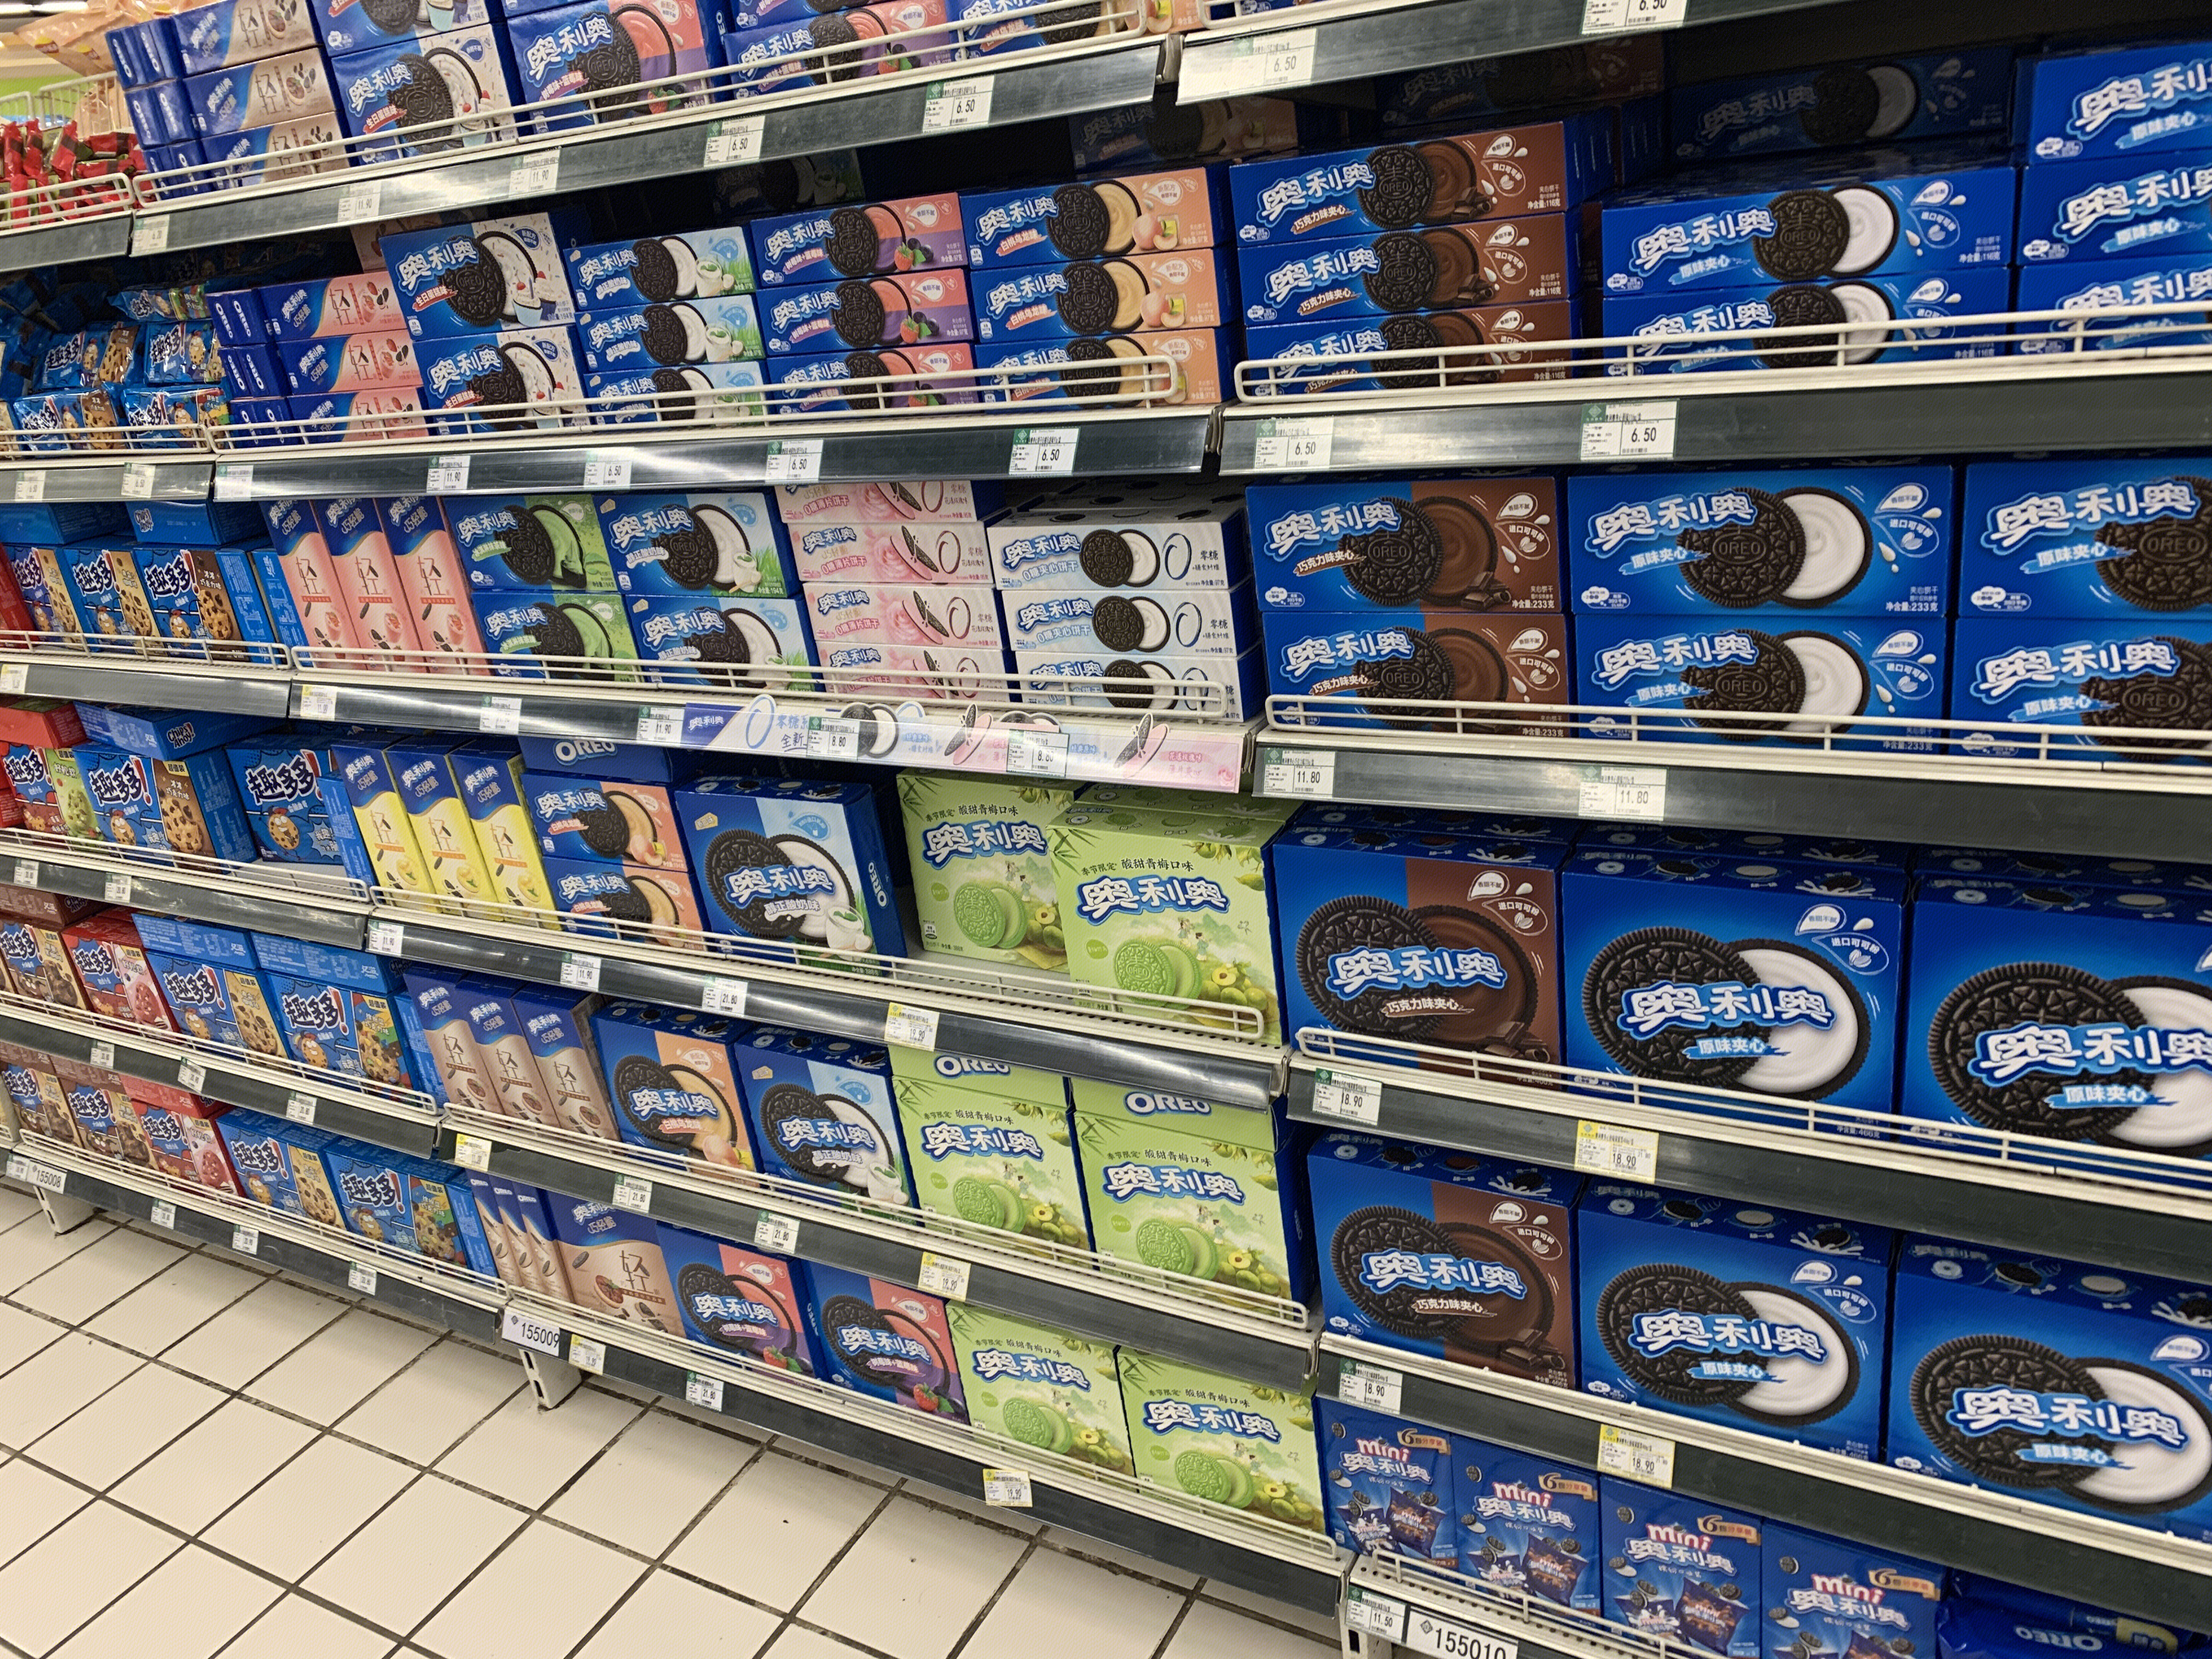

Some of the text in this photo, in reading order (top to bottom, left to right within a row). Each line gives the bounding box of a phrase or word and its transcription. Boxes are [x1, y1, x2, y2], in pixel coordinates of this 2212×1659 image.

[527, 16, 612, 80] 奥利奥
[1273, 56, 1297, 72] 6.50
[956, 99, 977, 114] 6.50
[365, 104, 399, 132] 生日蛋糕味
[2130, 111, 2197, 141] 原味夹心
[732, 137, 748, 152] 6.50
[532, 170, 549, 184] 11.90
[1381, 180, 1410, 193] OREO
[1261, 163, 1373, 221] 奥利奥
[979, 195, 1057, 239] 奥利奥
[1294, 204, 1347, 232] 巧克力味夹心
[767, 219, 833, 259] 奥利奥
[1000, 229, 1038, 252] 白桃乌龙味
[1634, 209, 1775, 272] 奥利奥
[2115, 217, 2181, 245] 原味夹心
[399, 238, 477, 287] 奥利奥
[1679, 255, 1731, 280] 原味夹心
[1269, 248, 1379, 301] 奥利奥
[415, 285, 448, 307] 生日蛋糕味
[1300, 287, 1353, 312] 巧克力味夹心
[1010, 304, 1048, 326] 白桃乌龙味
[1630, 427, 1657, 442] 6.50
[1041, 448, 1060, 461] 6.50
[1295, 441, 1317, 455] 6.50
[608, 465, 622, 477] 6.50
[791, 458, 808, 471] 6.50
[445, 471, 461, 483] 11.90
[1593, 494, 1755, 551] 奥利奥
[1990, 482, 2195, 547] 奥利奥
[457, 511, 517, 542] 奥利奥
[1272, 502, 1401, 552] 奥利奥
[1509, 524, 1545, 542] 进口可可粉
[1372, 544, 1407, 559] OREO
[1718, 540, 1762, 556] OREO
[2145, 532, 2200, 552] OREO
[1297, 549, 1356, 573] 巧克力味夹心
[1631, 547, 1688, 569] 原味夹心
[2036, 542, 2108, 567] 原味夹心
[1018, 597, 1094, 631] 奥利奥
[1511, 599, 1555, 609] 净含量:233克
[1886, 602, 1939, 612] 净含量:233克
[486, 607, 546, 635] 奥利奥
[645, 611, 723, 642] 奥利奥
[1036, 623, 1091, 643] 0糖夹心饼干
[1285, 631, 1412, 675] 奥利奥
[1598, 634, 1757, 685] 奥利奥
[1519, 657, 1555, 675] 进口可可粉
[1978, 641, 2176, 698] 奥利奥
[1312, 675, 1369, 694] 巧克力味夹心
[1385, 672, 1420, 685] OREO
[1721, 679, 1763, 693] OREO
[1637, 684, 1693, 702] 原味夹心
[2129, 691, 2180, 708] OREO
[2025, 696, 2092, 716] 原味夹心
[831, 735, 847, 748] 8.80
[1522, 727, 1565, 737] 净含量:233克
[555, 740, 617, 764] OREO
[1037, 749, 1054, 763] 8.80
[1296, 770, 1321, 784] 11.80
[1619, 789, 1650, 805] 11.80
[926, 822, 1047, 866] 奥利奥
[1121, 857, 1194, 872] 酸甜青梅口味
[1081, 875, 1227, 916] 奥利奥
[1498, 901, 1540, 916] 进口可可粉
[1831, 936, 1880, 955] 进口可可粉
[579, 968, 593, 980] 11.90
[1334, 949, 1504, 993] 奥利奥
[722, 992, 738, 1005] 21.80
[1386, 997, 1460, 1013] 巧克力味夹心
[1625, 983, 1833, 1032] 奥利奥
[909, 1028, 926, 1041] 19.90
[1698, 1040, 1766, 1054] 原味夹心
[1126, 1091, 1210, 1114] OREO
[1341, 1092, 1364, 1108] 18.90
[2064, 1086, 2147, 1103] 原味夹心
[780, 1117, 876, 1150] 奥利奥
[926, 1122, 1042, 1160] 奥利奥
[1612, 1152, 1637, 1167] 18.90
[36, 1169, 61, 1188] 155008
[470, 1178, 489, 1188] OREO
[1106, 1164, 1243, 1204] 奥利奥
[518, 1195, 538, 1205] OREO
[631, 1191, 646, 1203] 21.80
[774, 1230, 789, 1242] 21.80
[1517, 1227, 1555, 1245] 进口可可粉
[941, 1277, 958, 1290] 19.90
[1367, 1252, 1525, 1295] 奥利奥
[695, 1297, 778, 1325] 奥利奥
[1417, 1298, 1483, 1314] 巧克力味夹心
[521, 1321, 560, 1348] 155009
[842, 1324, 932, 1364] 奥利奥
[1636, 1312, 1825, 1361] 奥利奥
[976, 1350, 1091, 1389] 奥利奥
[1702, 1361, 1765, 1378] 原味夹心
[1364, 1382, 1386, 1397] 18.90
[1147, 1400, 1279, 1441] 奥利奥
[1956, 1389, 2188, 1447] 奥利奥
[1355, 1438, 1410, 1463] mini
[2034, 1446, 2109, 1464] 原味夹心
[1632, 1457, 1655, 1472] 18.90
[1006, 1487, 1022, 1499] 19.90
[1493, 1482, 1553, 1508] mini
[1646, 1523, 1711, 1551] mini
[1627, 1538, 1735, 1576] 奥利奥
[1811, 1573, 1884, 1603] mini
[1374, 1612, 1393, 1627] 11.50
[1435, 1626, 1506, 1659] 155010
[2015, 1626, 2103, 1651] OREO
